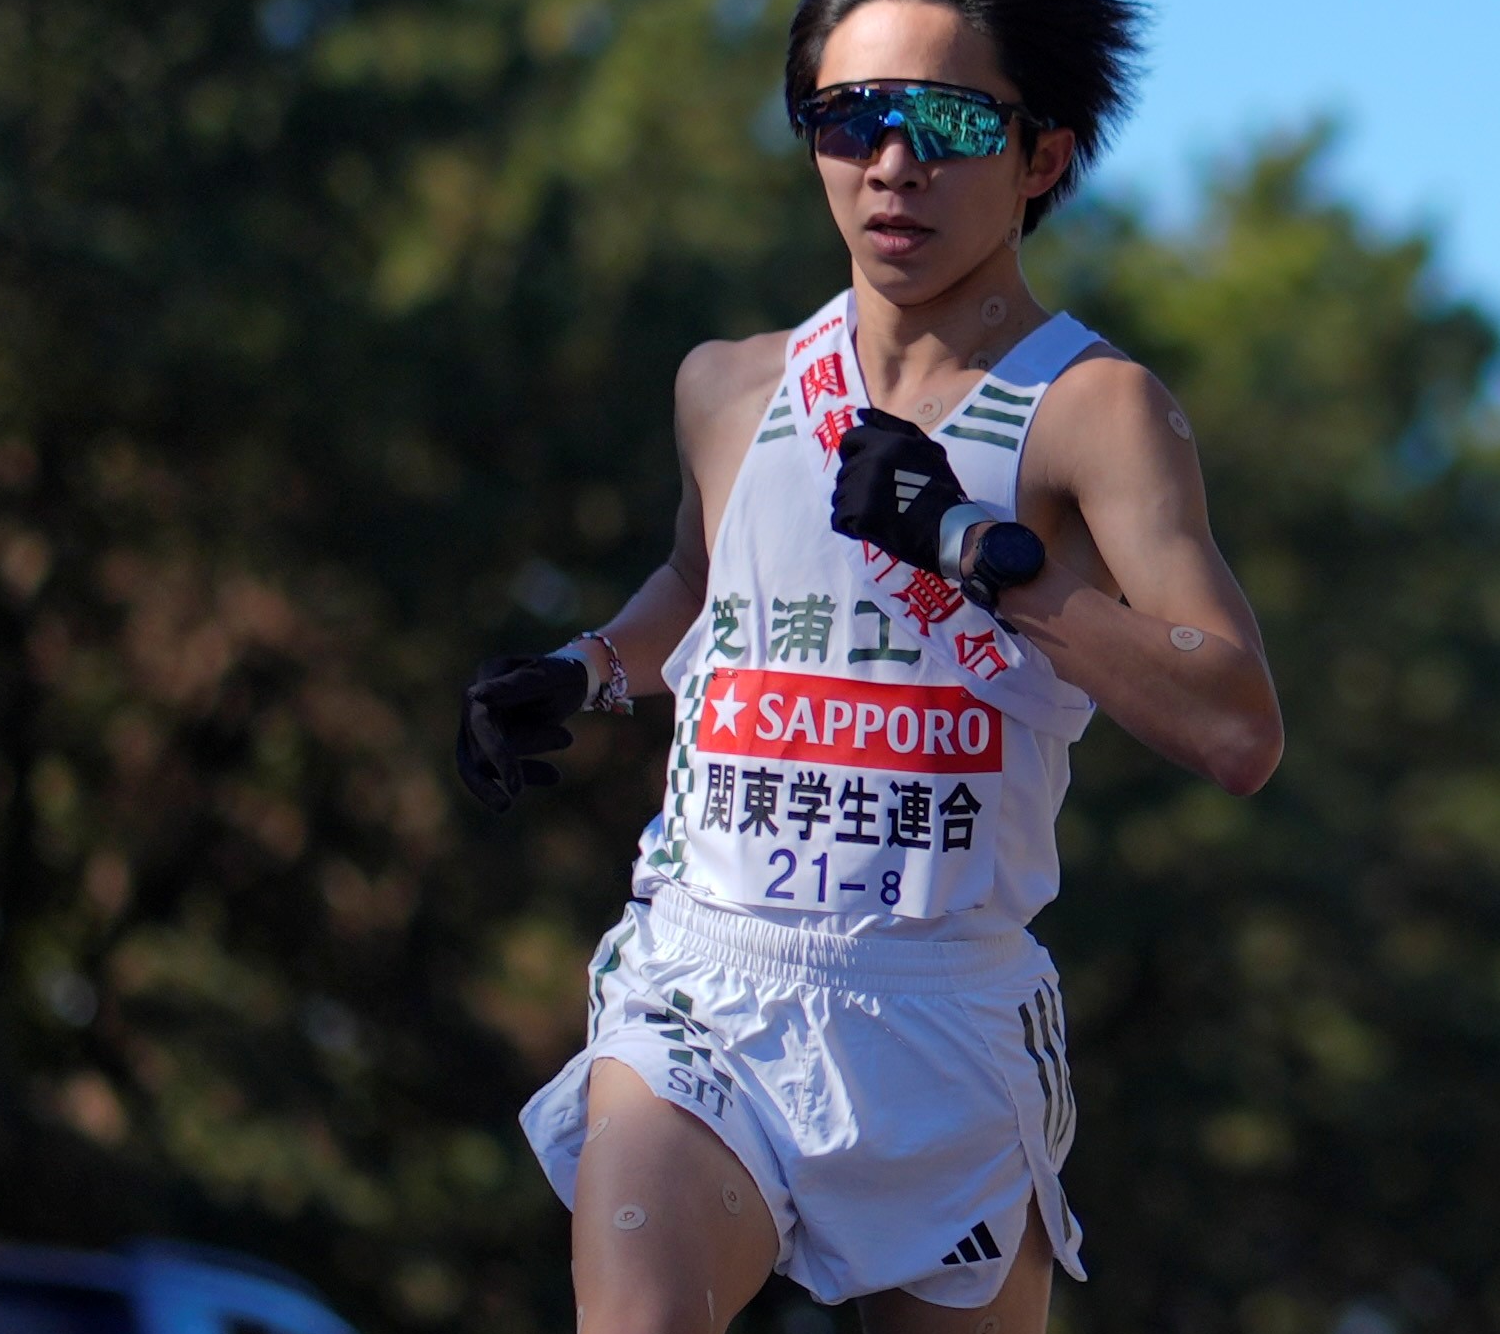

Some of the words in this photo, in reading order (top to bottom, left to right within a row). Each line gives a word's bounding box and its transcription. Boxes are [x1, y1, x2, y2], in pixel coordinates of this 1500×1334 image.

[755, 692, 990, 755] SAPPORO
[700, 763, 982, 853] 関東学生連合
[765, 848, 901, 906] 21-8
[668, 1067, 733, 1122] SIT
